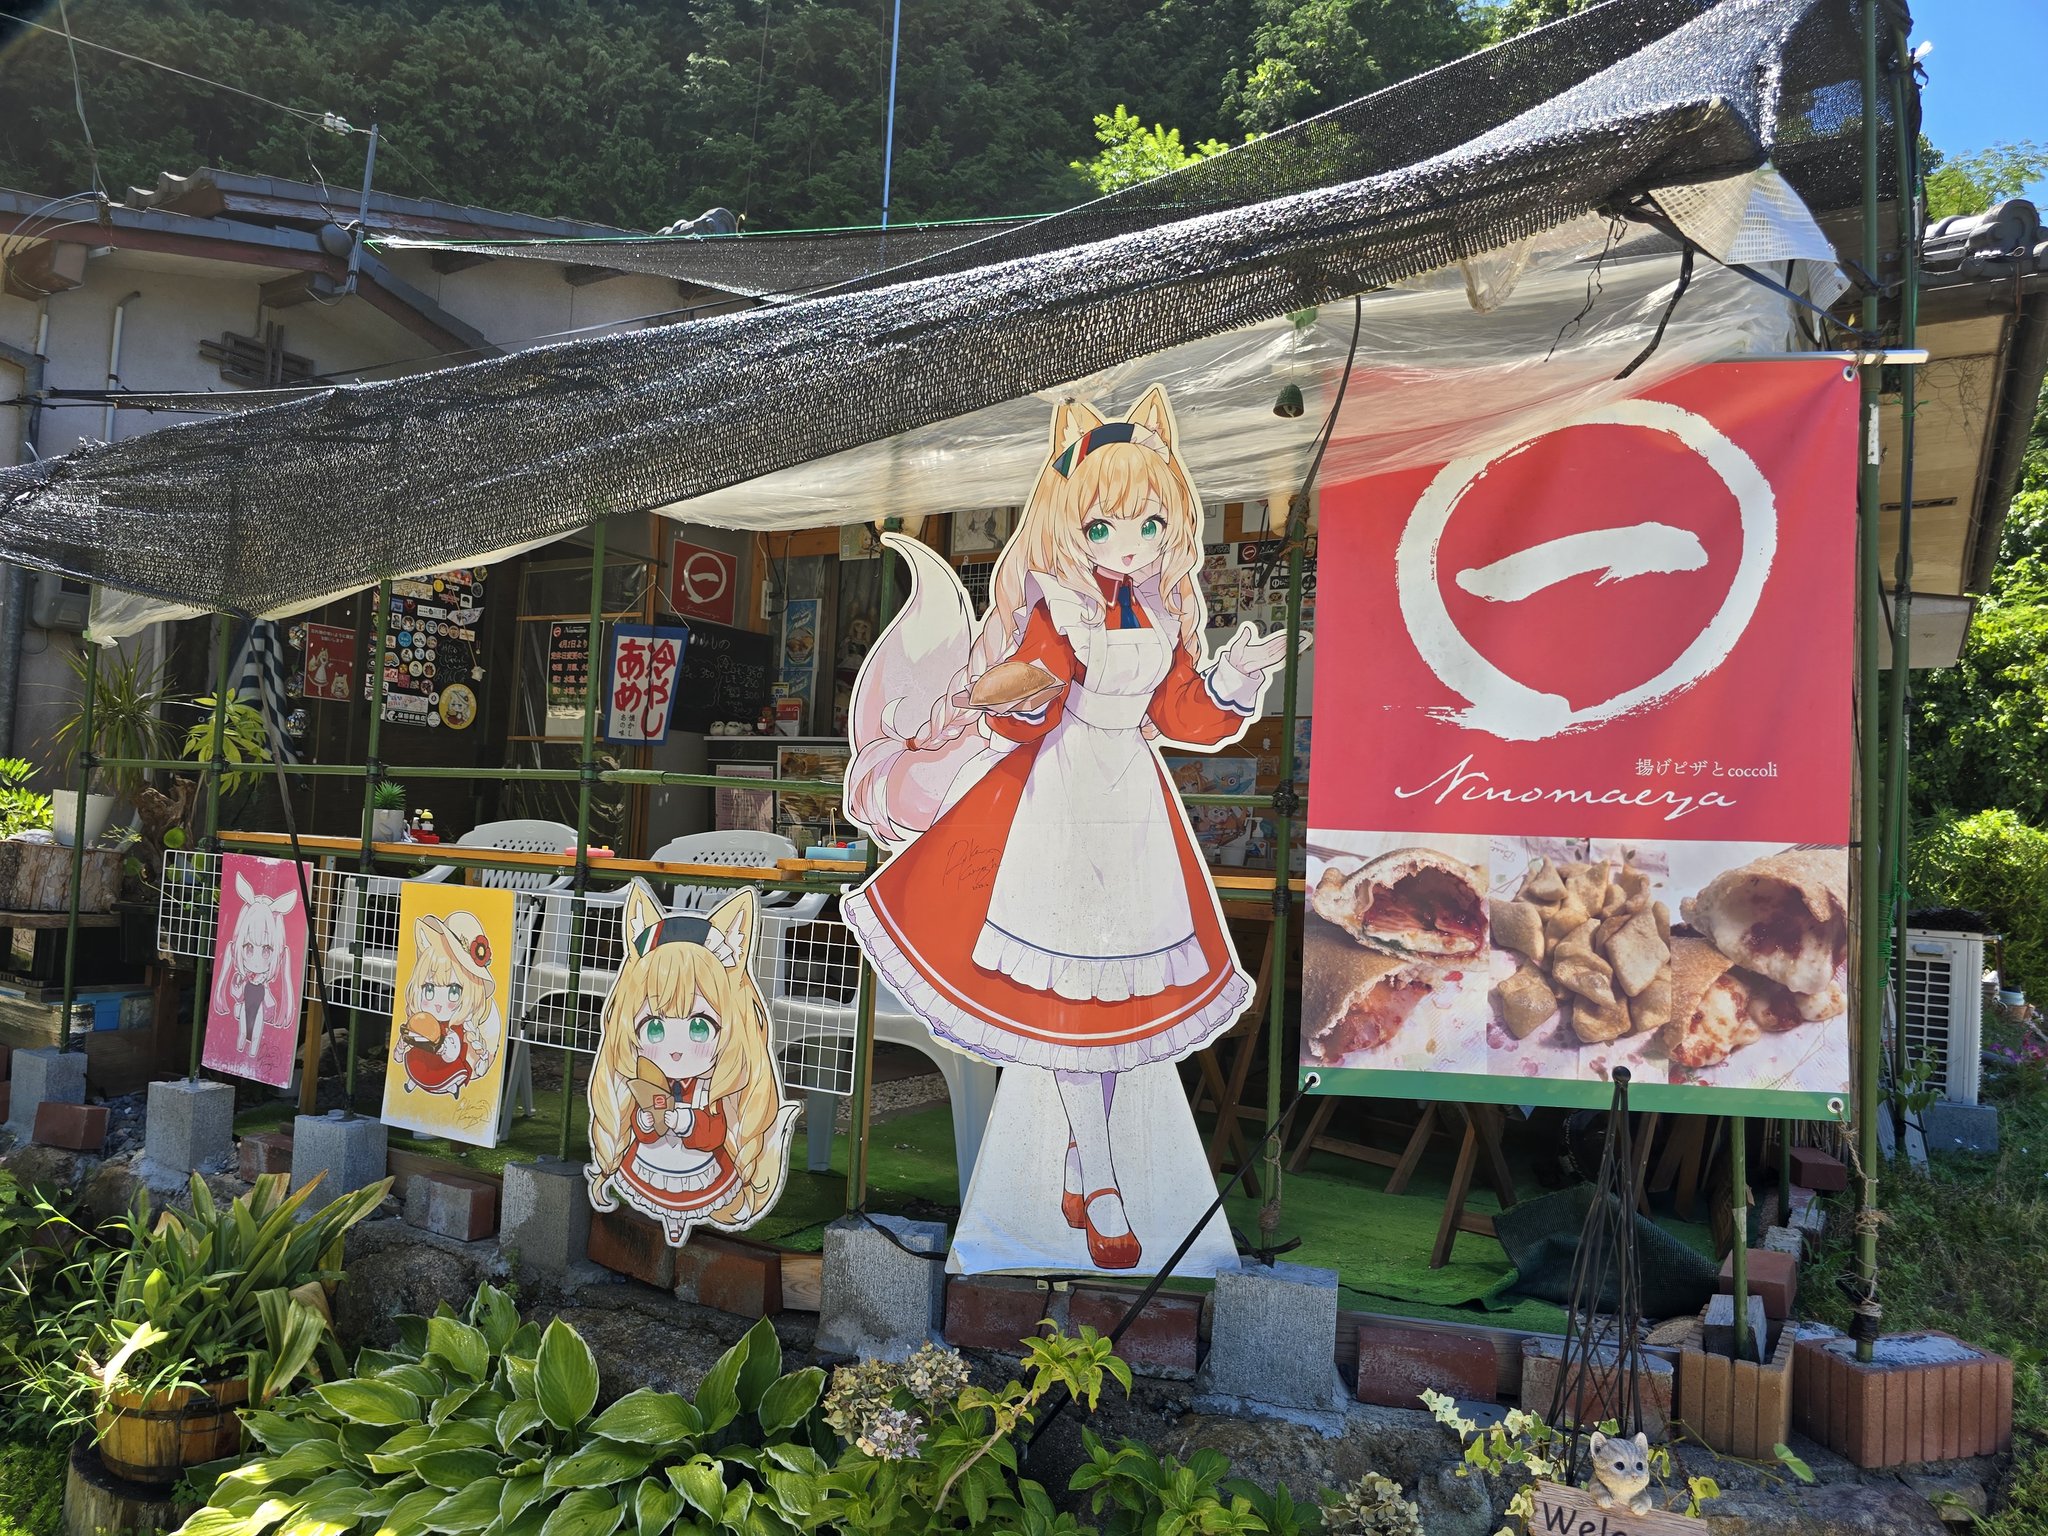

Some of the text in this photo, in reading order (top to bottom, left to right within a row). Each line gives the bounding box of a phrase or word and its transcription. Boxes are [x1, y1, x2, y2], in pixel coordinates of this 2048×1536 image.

[614, 638, 645, 712] あめ
[640, 640, 676, 737] 冷やし
